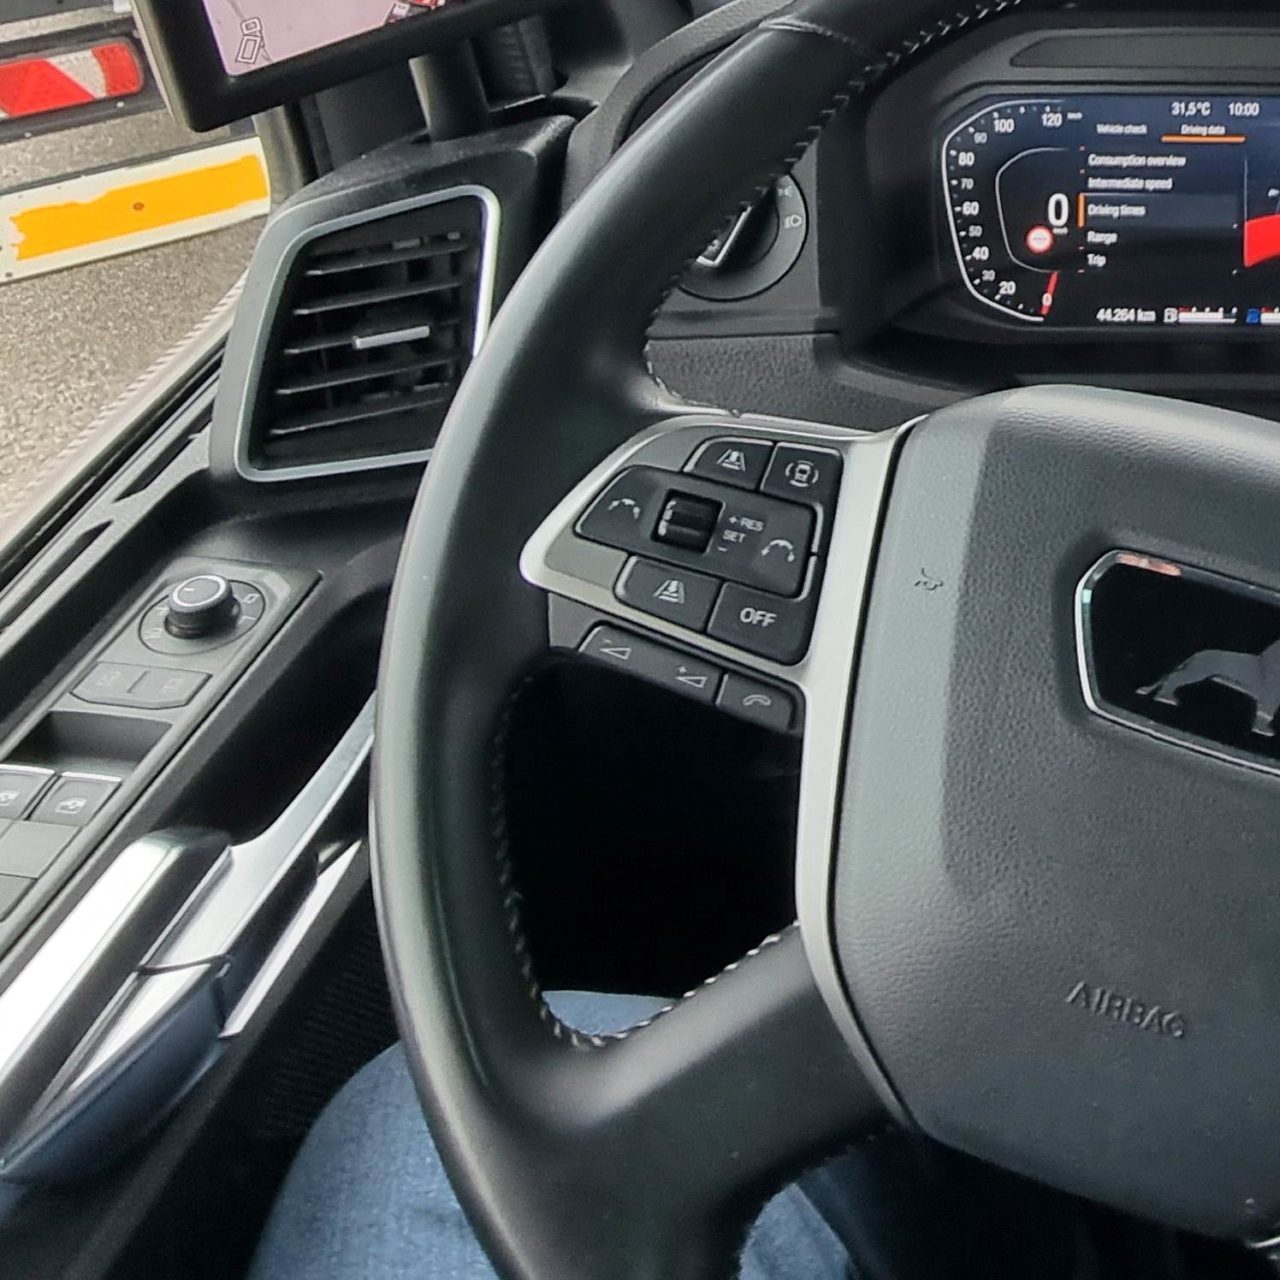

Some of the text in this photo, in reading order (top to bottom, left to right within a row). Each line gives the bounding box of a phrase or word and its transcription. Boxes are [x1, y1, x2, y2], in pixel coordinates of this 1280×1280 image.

[1228, 102, 1260, 116] 10:00
[993, 118, 1015, 133] 100
[1042, 113, 1062, 127] 120
[1097, 123, 1147, 135] Vehicle check
[1181, 124, 1226, 136] Driving data
[958, 152, 975, 166] 80
[1088, 153, 1187, 168] Consumption overview
[961, 178, 974, 190] 70
[1088, 177, 1173, 191] Intermediate speed
[962, 201, 979, 216] 60
[1047, 193, 1069, 227] 0
[1087, 204, 1146, 219] Driving times
[968, 225, 982, 238] 50
[1087, 231, 1118, 245] Range
[972, 246, 989, 261] 40
[1087, 253, 1107, 267] Trip
[999, 281, 1016, 295] 20
[1042, 293, 1052, 307] 0
[1137, 309, 1156, 322] km
[740, 516, 765, 532] RES
[722, 529, 747, 543] SET
[739, 606, 778, 626] OFF
[1066, 980, 1185, 1038] AIRBAG
